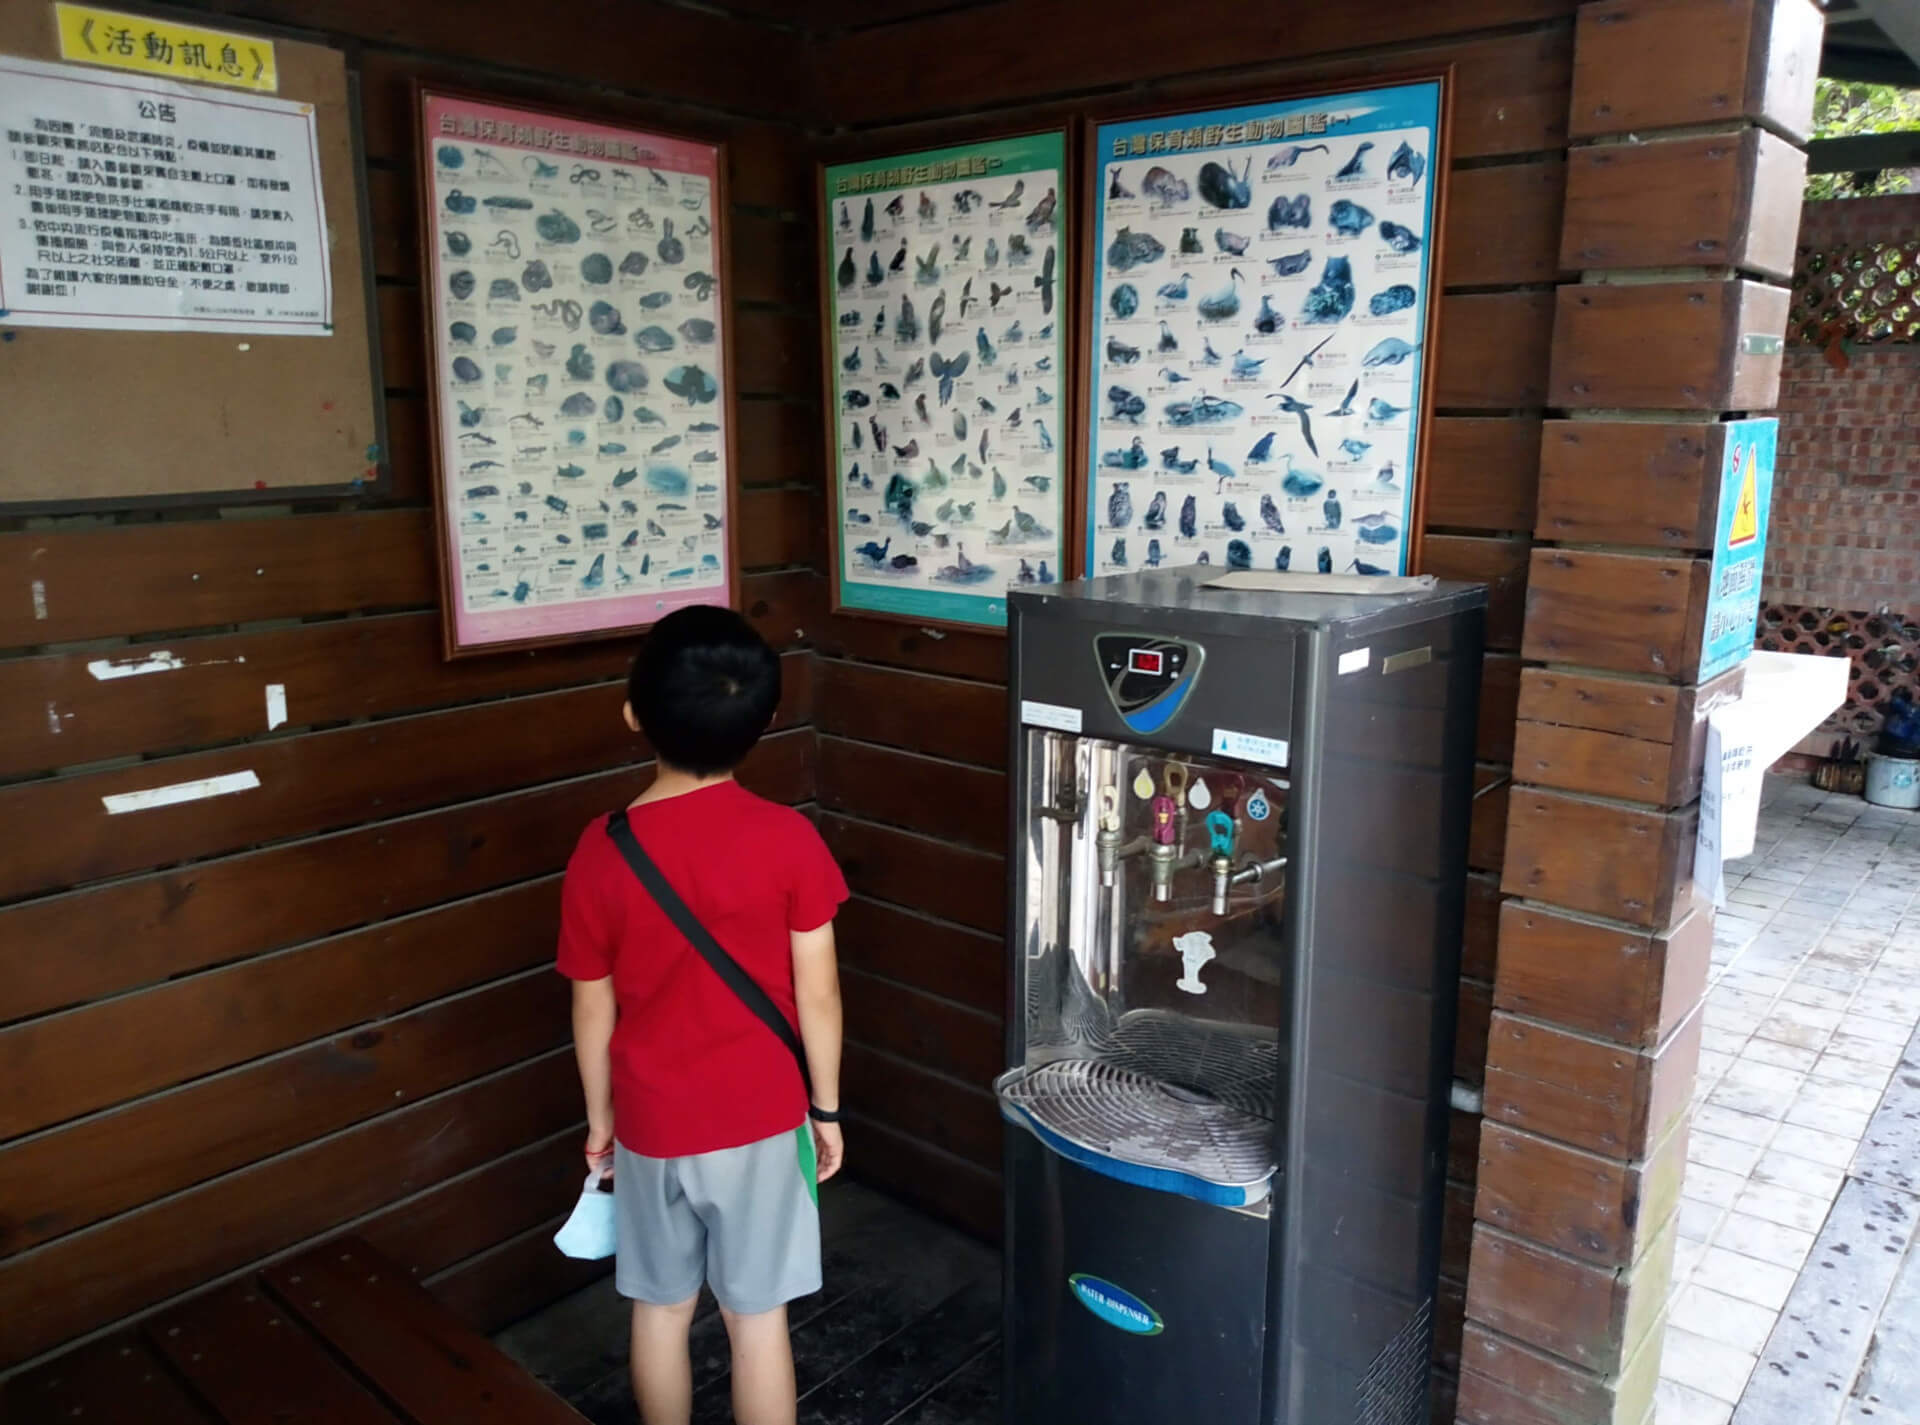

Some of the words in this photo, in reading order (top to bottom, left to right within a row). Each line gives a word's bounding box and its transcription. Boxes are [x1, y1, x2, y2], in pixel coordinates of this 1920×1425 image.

[81, 19, 264, 80] 《活動訊息》
[138, 100, 177, 123] 公告
